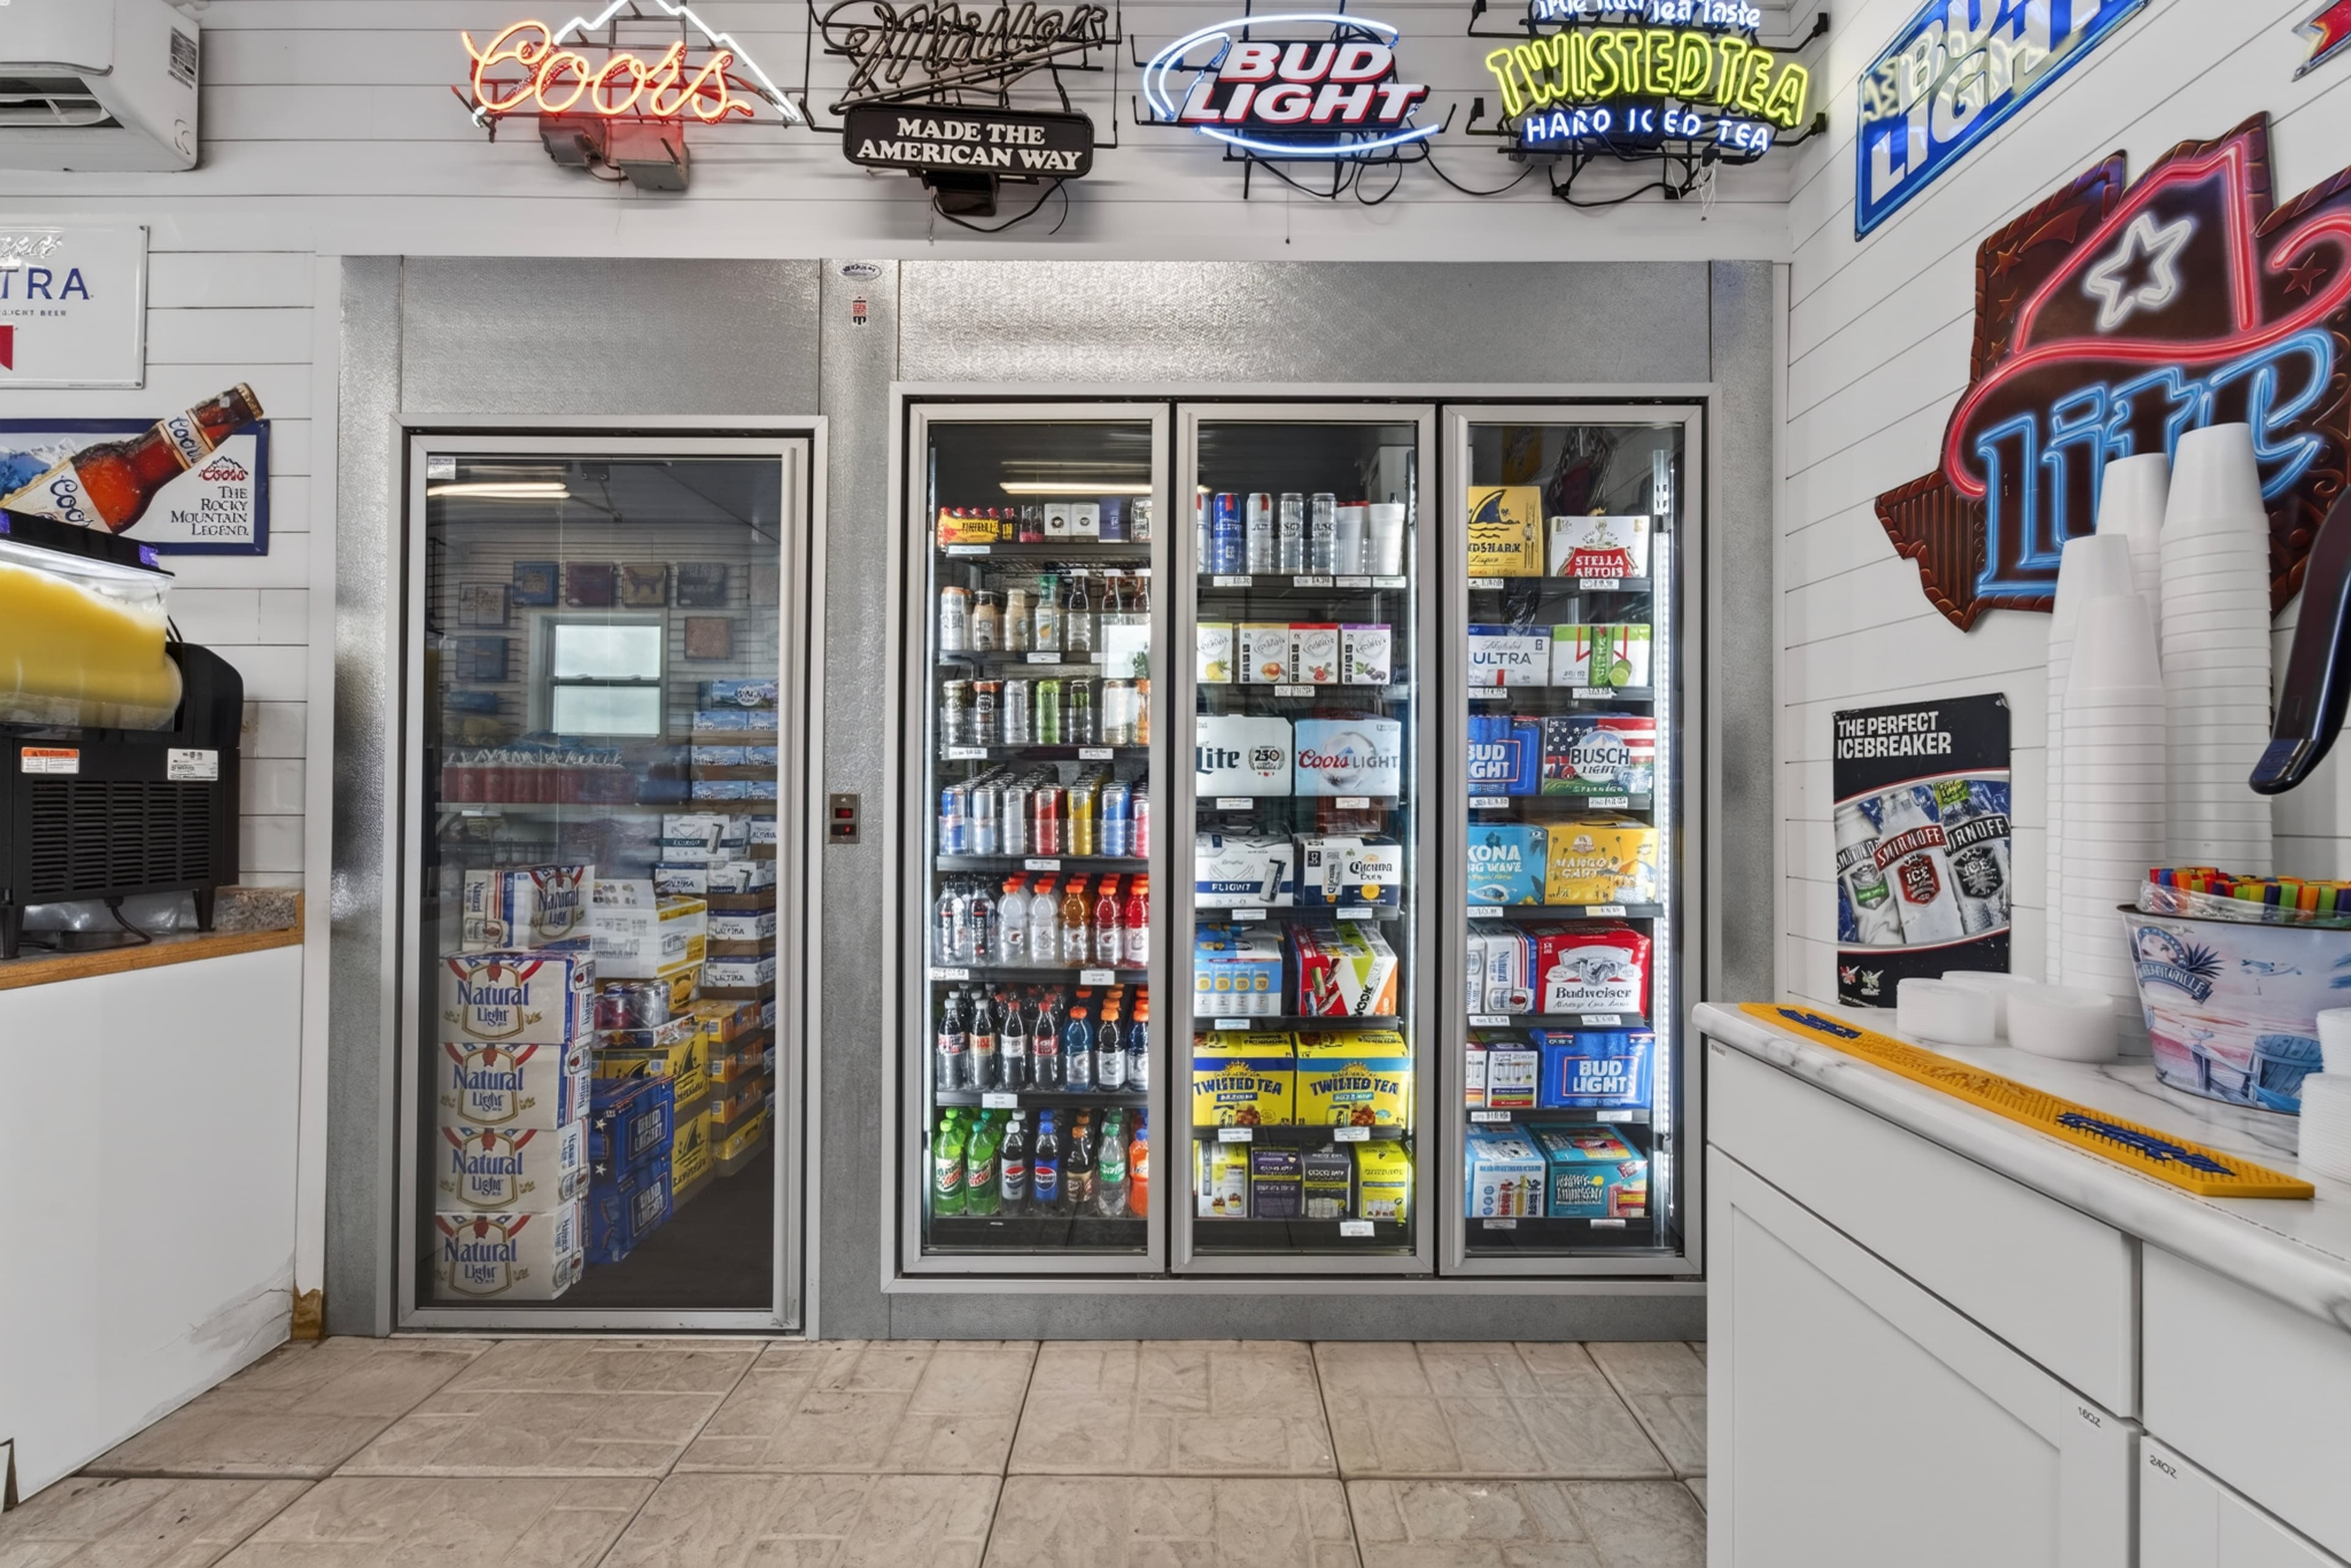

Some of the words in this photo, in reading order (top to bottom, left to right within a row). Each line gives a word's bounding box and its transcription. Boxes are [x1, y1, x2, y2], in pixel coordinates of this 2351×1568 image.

[462, 20, 754, 124] Coors
[1219, 42, 1395, 83] BUD
[1486, 29, 1713, 116] TWISTED
[1719, 37, 1809, 127] TEA
[1180, 83, 1430, 122] LIGHT
[896, 117, 981, 139] MADE
[986, 122, 1046, 144] THE
[1717, 119, 1769, 152] TEA
[857, 139, 1014, 167] AMERICAN
[1016, 149, 1083, 171] WAY
[217, 486, 248, 499] THE
[201, 498, 248, 511] ROCKY
[171, 510, 248, 523] MOUNTAIN
[1575, 555, 1624, 566] STELLA
[1473, 652, 1532, 665] ULTRA
[1837, 715, 1865, 738] THE
[1867, 711, 1939, 735] PERFECT
[1837, 732, 1952, 760] ICEBREAKER
[1298, 749, 1350, 770] Coors
[1352, 756, 1399, 770] LIGHT
[1570, 748, 1630, 765] BUSCH
[1582, 765, 1616, 775] LIGHT
[457, 980, 530, 1007] Natural
[1555, 986, 1632, 999] Budweiser
[476, 1007, 509, 1026] Light
[1579, 1060, 1622, 1076] BUD
[452, 1067, 524, 1092] Natural
[1194, 1078, 1254, 1096] TWISTED
[1257, 1079, 1283, 1095] TEA
[1373, 1079, 1400, 1095] TEA
[1573, 1076, 1627, 1092] LIGHT
[472, 1091, 504, 1111] Light
[452, 1149, 523, 1176] Natural
[471, 1176, 504, 1196] Light
[444, 1237, 517, 1262] Natural
[464, 1265, 498, 1285] Light
